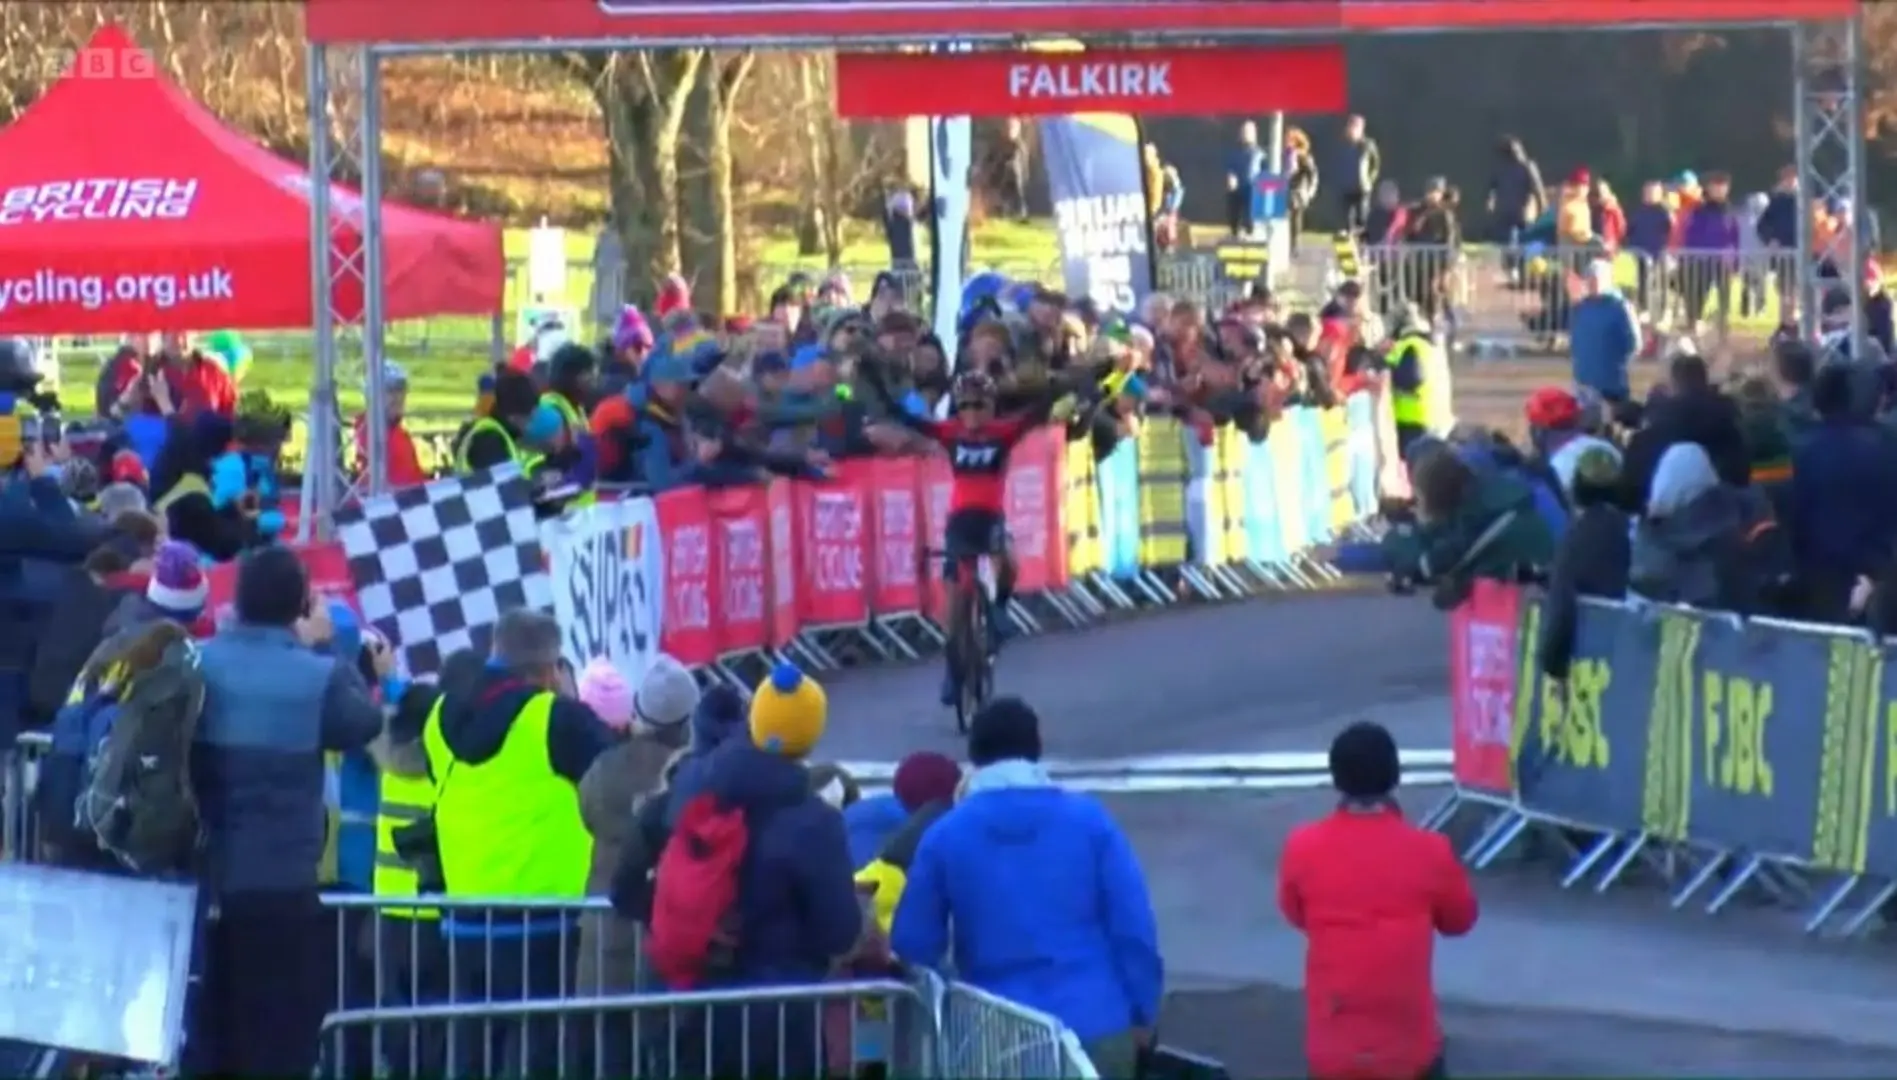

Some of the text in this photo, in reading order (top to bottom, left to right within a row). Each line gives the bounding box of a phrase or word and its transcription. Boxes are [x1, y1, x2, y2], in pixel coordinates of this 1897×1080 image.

[1009, 63, 1173, 97] FALKIRK
[0, 197, 190, 224] CYCLING
[3, 178, 197, 213] BRITISH
[0, 266, 233, 312] ycling.org.uk
